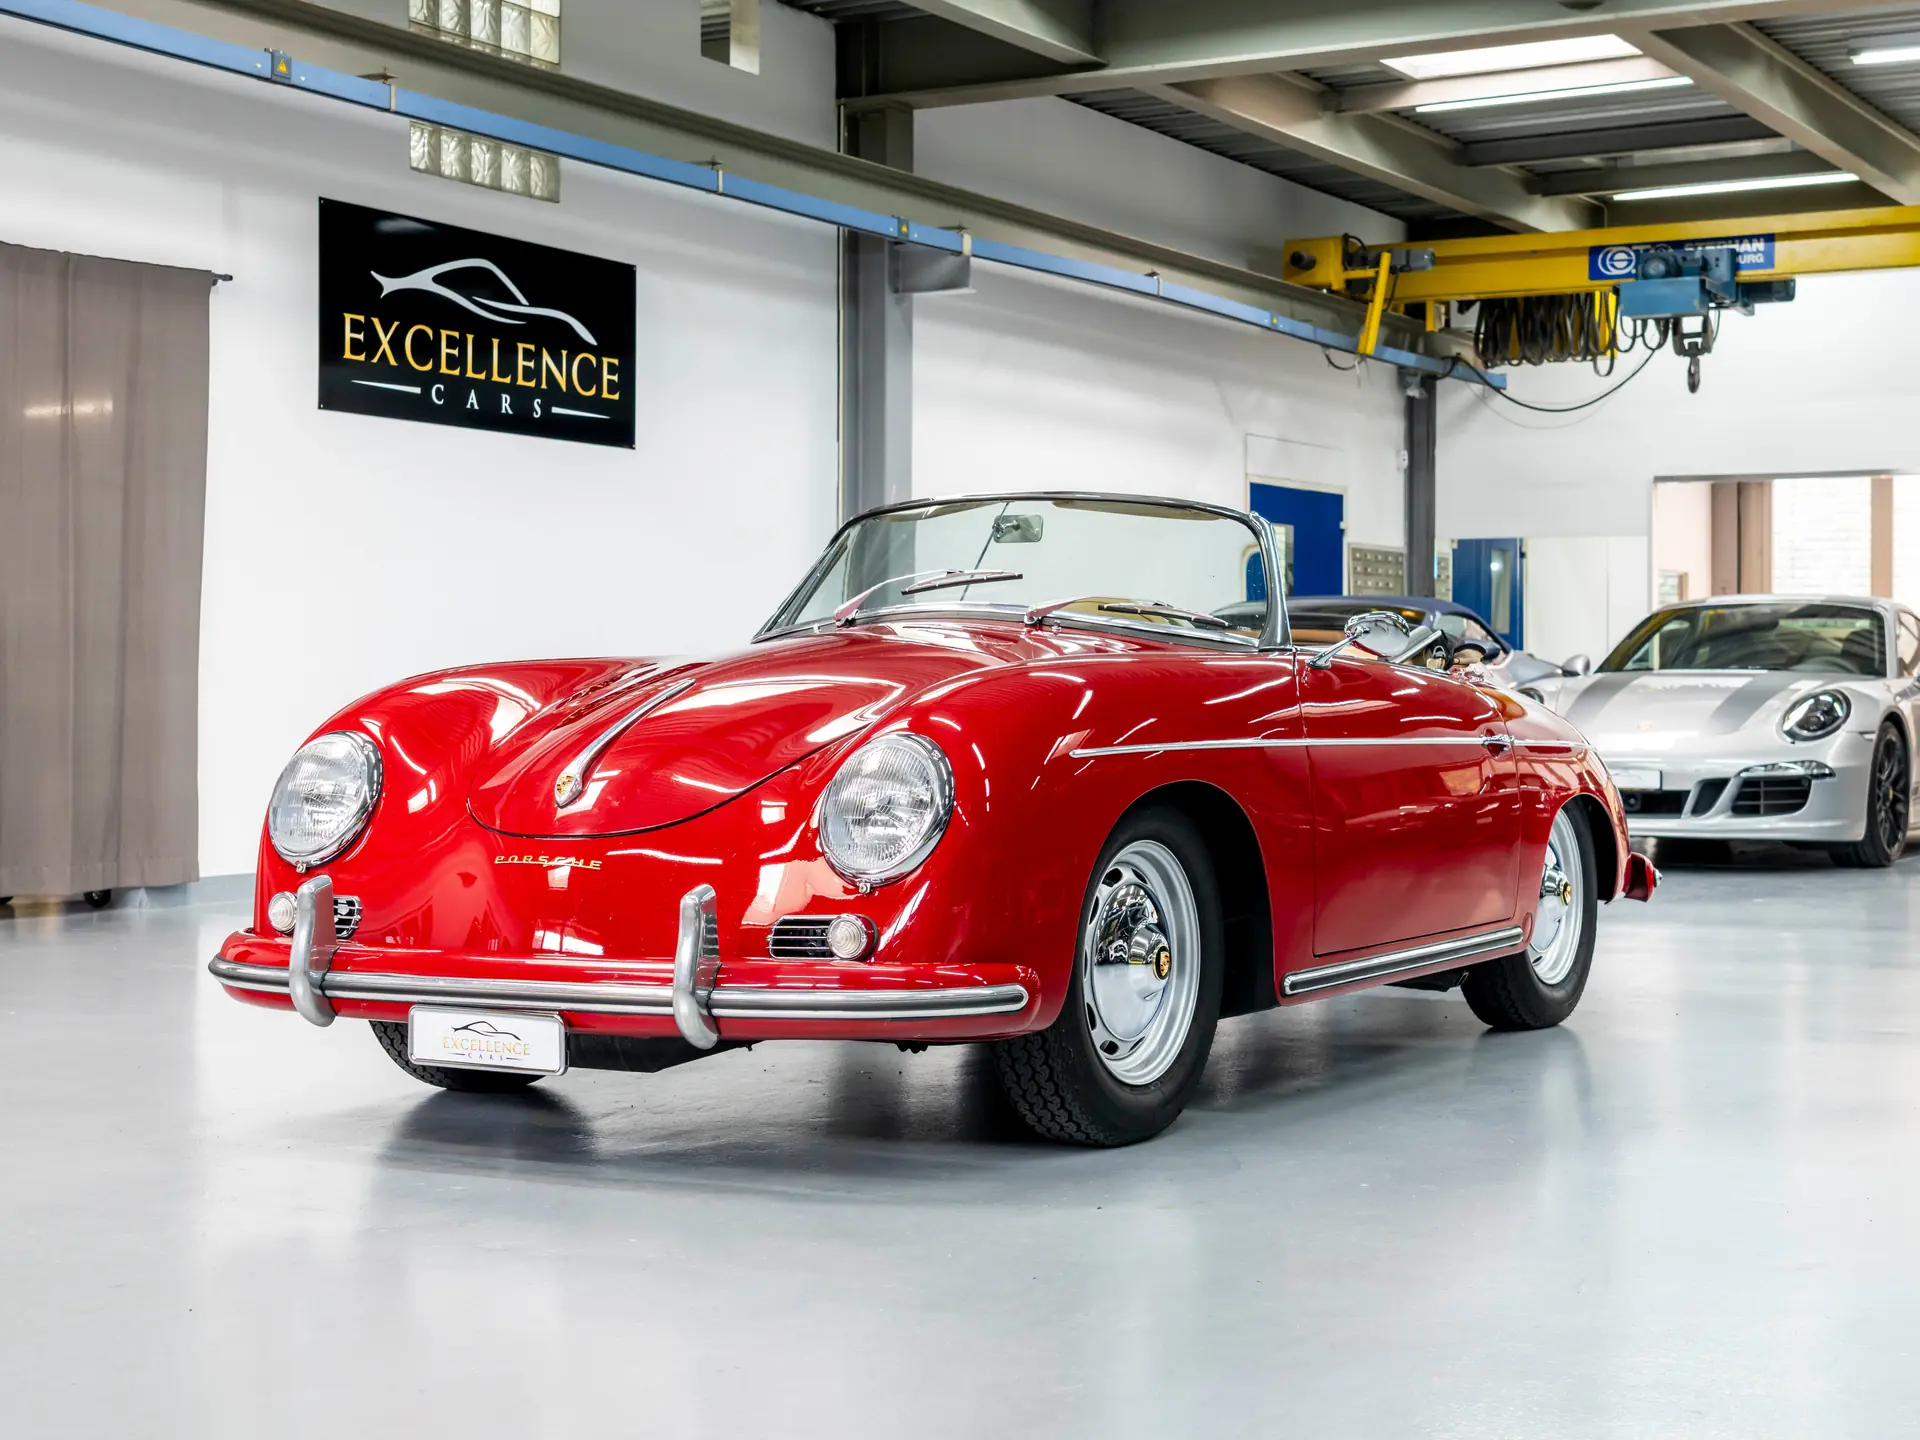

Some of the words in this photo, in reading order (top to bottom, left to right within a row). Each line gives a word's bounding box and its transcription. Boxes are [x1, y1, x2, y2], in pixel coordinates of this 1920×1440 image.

[343, 312, 620, 400] EXCELLENCE
[431, 384, 542, 418] CARS
[494, 855, 602, 870] PORSCHE
[443, 1036, 531, 1056] EXCELLENCE
[467, 1052, 504, 1061] CARS
